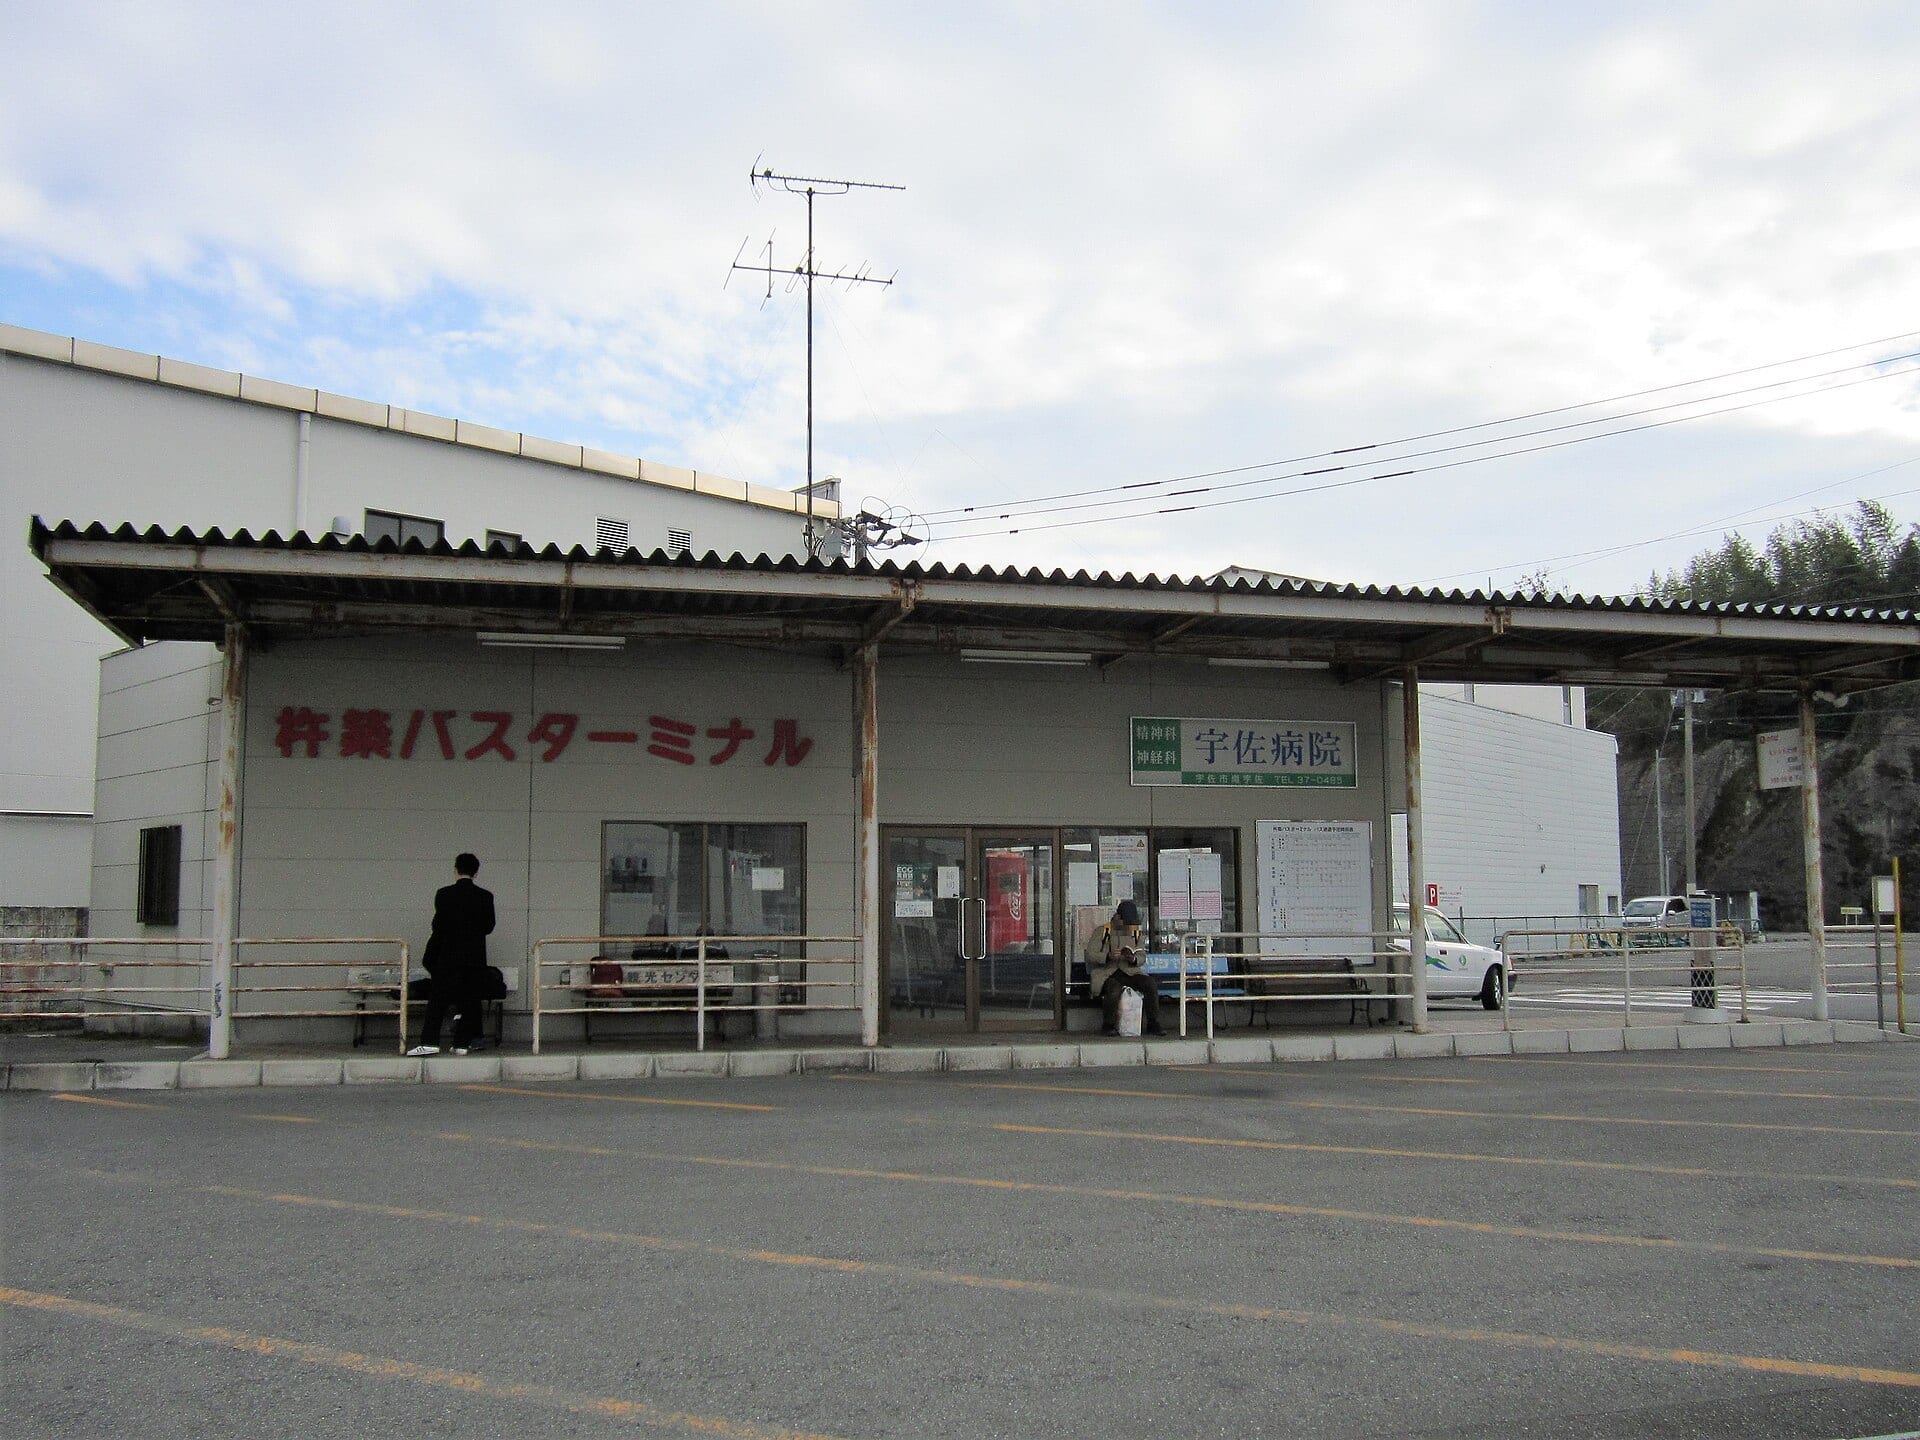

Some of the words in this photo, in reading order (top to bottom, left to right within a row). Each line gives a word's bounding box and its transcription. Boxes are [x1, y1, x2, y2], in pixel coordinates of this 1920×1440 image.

[275, 706, 813, 766] 杵築バスターミナル
[1136, 725, 1177, 741] 精神科
[1195, 728, 1342, 767] 宇佐病院
[1136, 750, 1177, 765] 神経科
[1274, 776, 1293, 785] TEL
[1430, 887, 1436, 903] P
